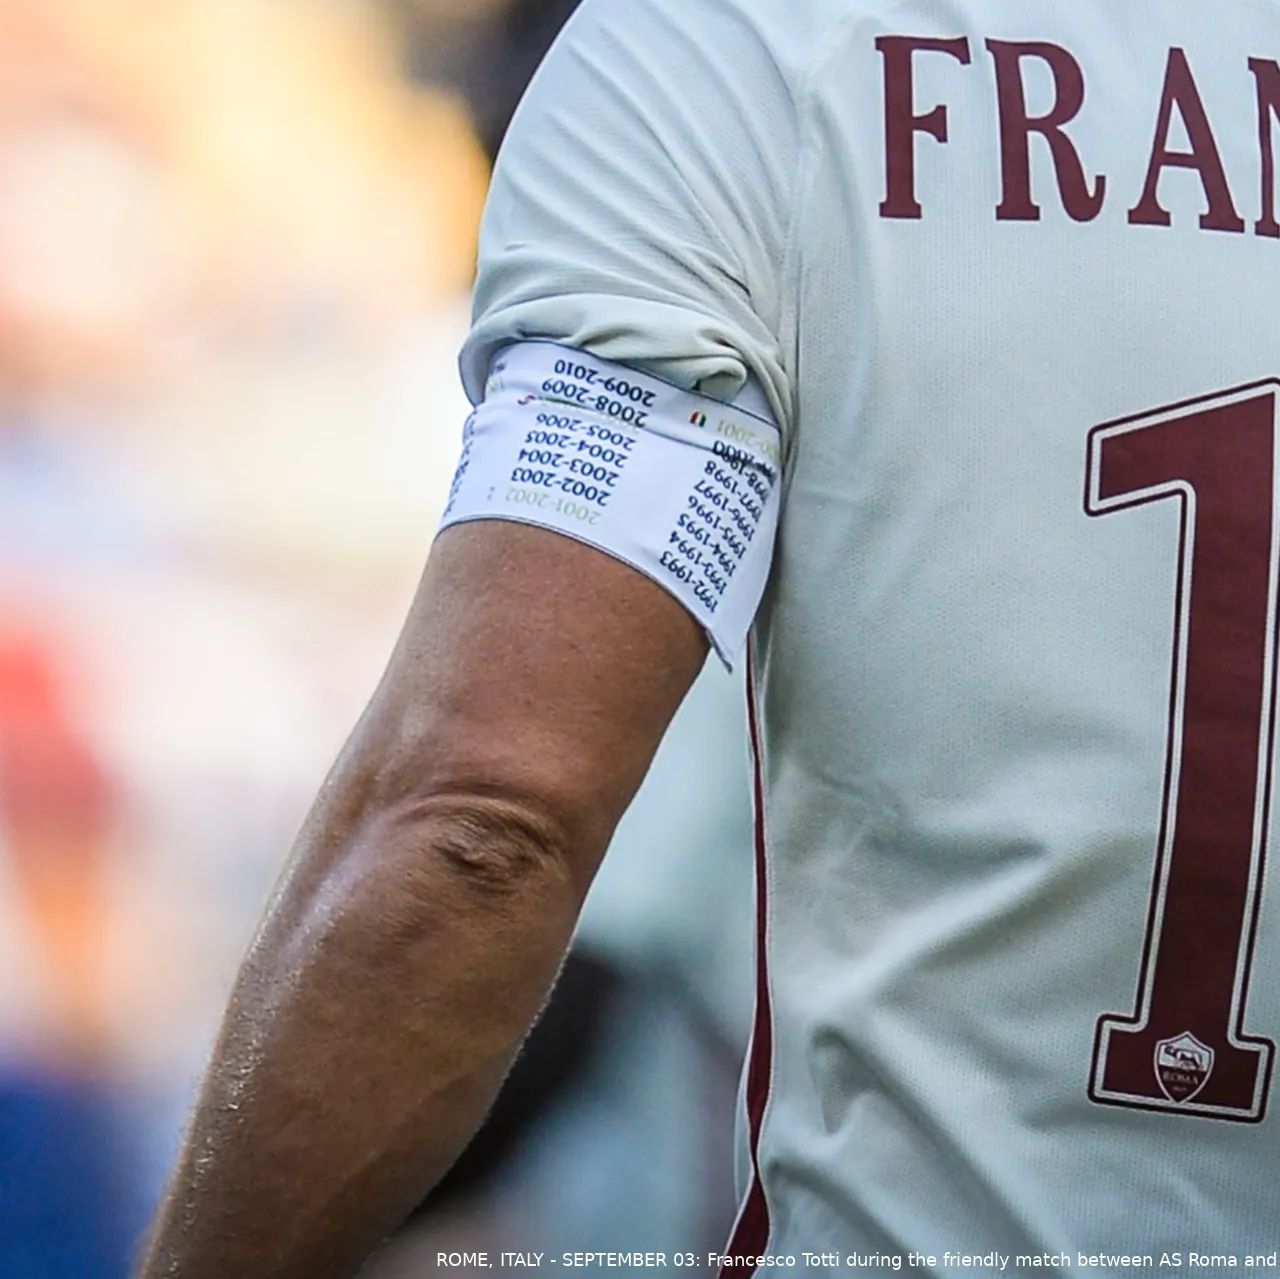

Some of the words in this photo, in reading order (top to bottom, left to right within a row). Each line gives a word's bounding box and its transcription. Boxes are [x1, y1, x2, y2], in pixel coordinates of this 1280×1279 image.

[541, 377, 648, 428] 2008-2009
[554, 359, 657, 407] 2009-2010
[524, 430, 628, 469] 2004-2005
[536, 413, 636, 451] 2005-2006
[510, 467, 612, 507] 2002-2003
[518, 449, 620, 487] 2003-2004
[505, 487, 603, 525] 2001-2002
[688, 495, 747, 559] 1995-1996
[694, 478, 756, 542] 1996-1997
[669, 531, 728, 595] 1993-1994
[677, 513, 737, 577] 1994-1995
[659, 551, 718, 613] 1992-1993
